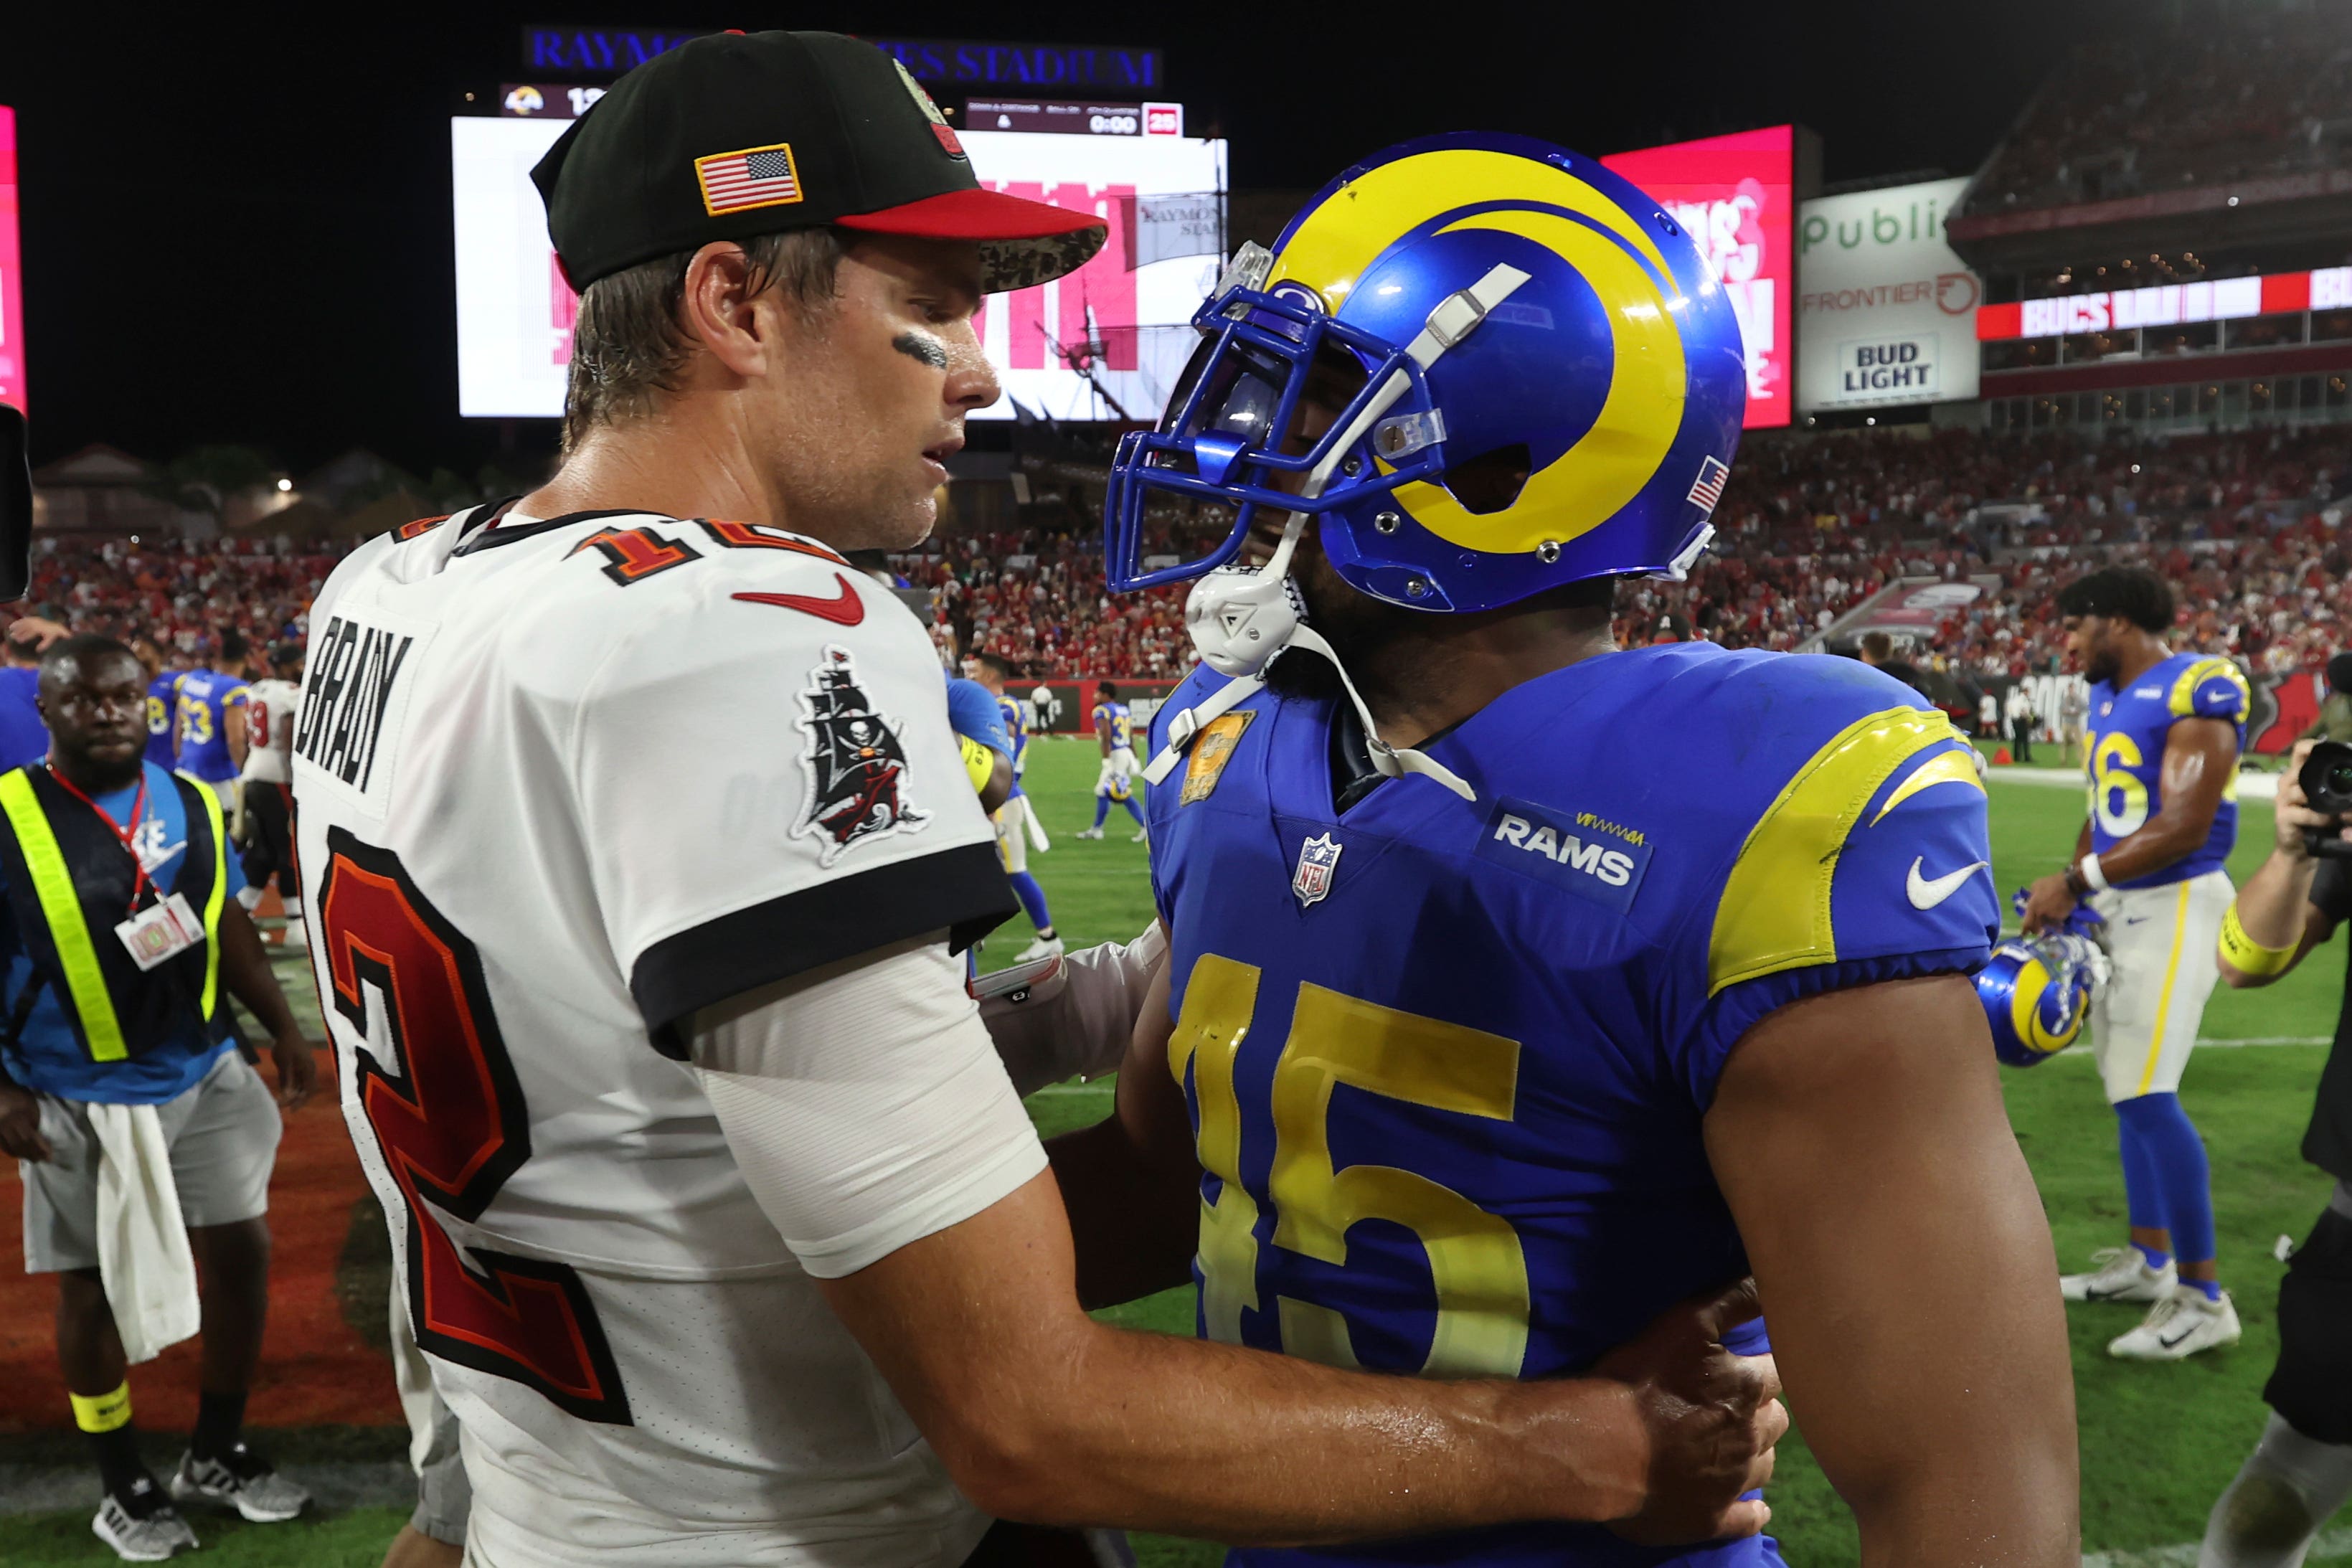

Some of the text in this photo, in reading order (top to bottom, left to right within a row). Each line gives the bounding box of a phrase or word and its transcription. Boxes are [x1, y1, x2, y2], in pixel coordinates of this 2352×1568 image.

[533, 30, 693, 69] RAYM
[955, 44, 1155, 87] STADIUM
[1089, 115, 1138, 134] 0:00
[1149, 113, 1177, 132] 25
[1800, 199, 1936, 253] Publi
[1800, 280, 1935, 311] FRONTIER
[2024, 293, 2108, 335] BUCS
[1856, 341, 1919, 368] BUD
[1844, 364, 1933, 392] LIGHT
[295, 615, 415, 794] BRADY
[1493, 813, 1635, 887] RAMS
[1297, 864, 1326, 894] NFL
[1167, 952, 1531, 1379] 45
